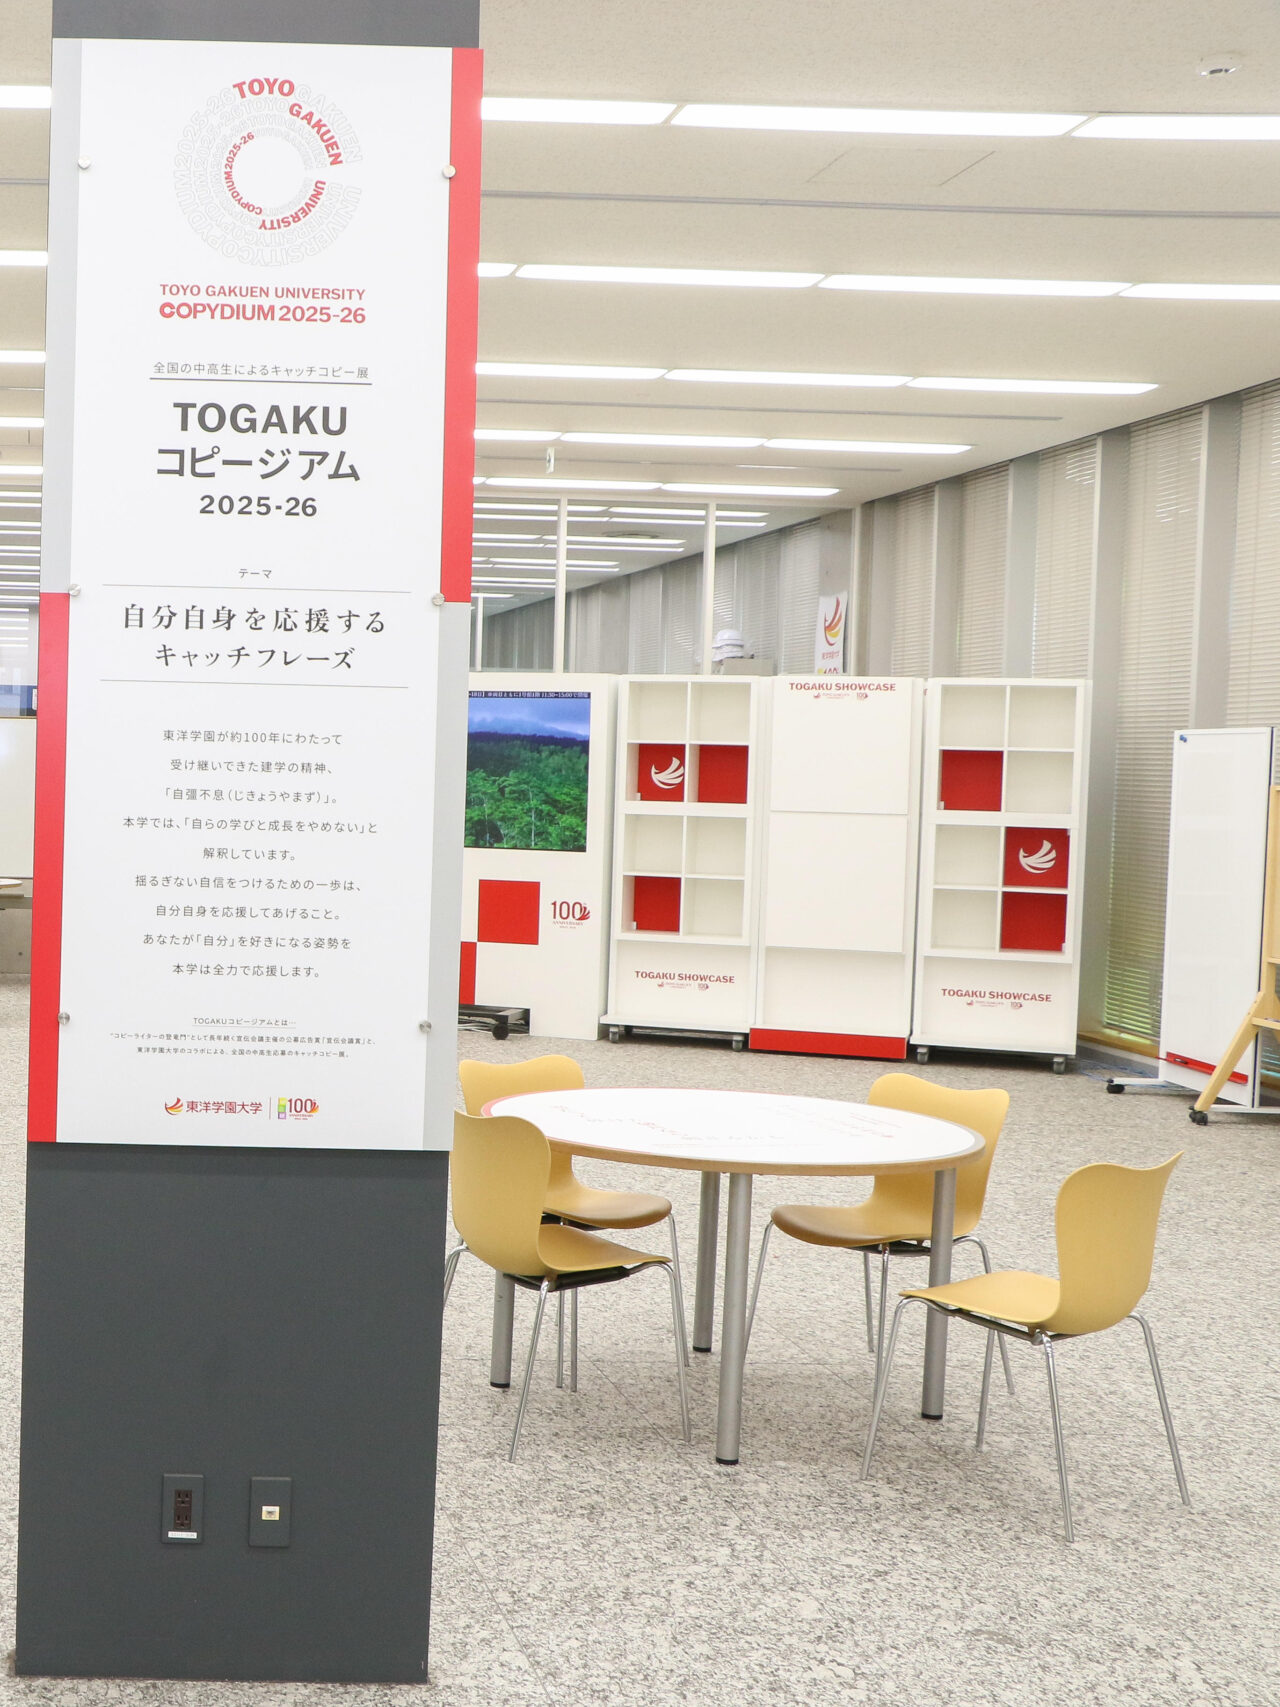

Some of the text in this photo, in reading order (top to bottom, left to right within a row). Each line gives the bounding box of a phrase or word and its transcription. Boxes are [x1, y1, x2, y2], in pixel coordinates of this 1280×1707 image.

[232, 78, 295, 99] TOYO
[288, 102, 343, 166] GAKUEN
[258, 180, 326, 230] UNIVERSITY
[160, 284, 366, 301] TOYO GAKUEN UNIVERSITY
[158, 301, 367, 324] COPYDIUM 2025-26
[152, 361, 370, 380] 全国の中高生によるキャッチコピー展
[172, 402, 348, 436] TOGAKU
[156, 445, 361, 483] コピージアム
[199, 494, 318, 517] 2025-26
[238, 567, 273, 580] テーマ
[123, 602, 386, 634] 自分自身を応援する
[155, 643, 356, 670] キャッチフレーズ
[789, 682, 896, 691] TOGAKU SHOWCASE
[162, 729, 344, 746] 東洋学園が約100年にわたって
[170, 759, 333, 775] 受け継いできた建学の精神、
[202, 847, 297, 862] 解釈しています。
[135, 874, 363, 892] 揺るぎない自信をつけるための一歩は、
[155, 904, 342, 921] 自分自身を応援してあげること。
[551, 900, 583, 920] 100
[143, 933, 352, 951] あなたが「自分」を好きになる姿勢を
[172, 963, 321, 979] 本学は全力で応援します。
[635, 970, 735, 983] TOGAKU SHOWCASE
[941, 988, 1053, 1002] TOGAKU SHOWCASE
[186, 1100, 263, 1115] 東洋学園大学
